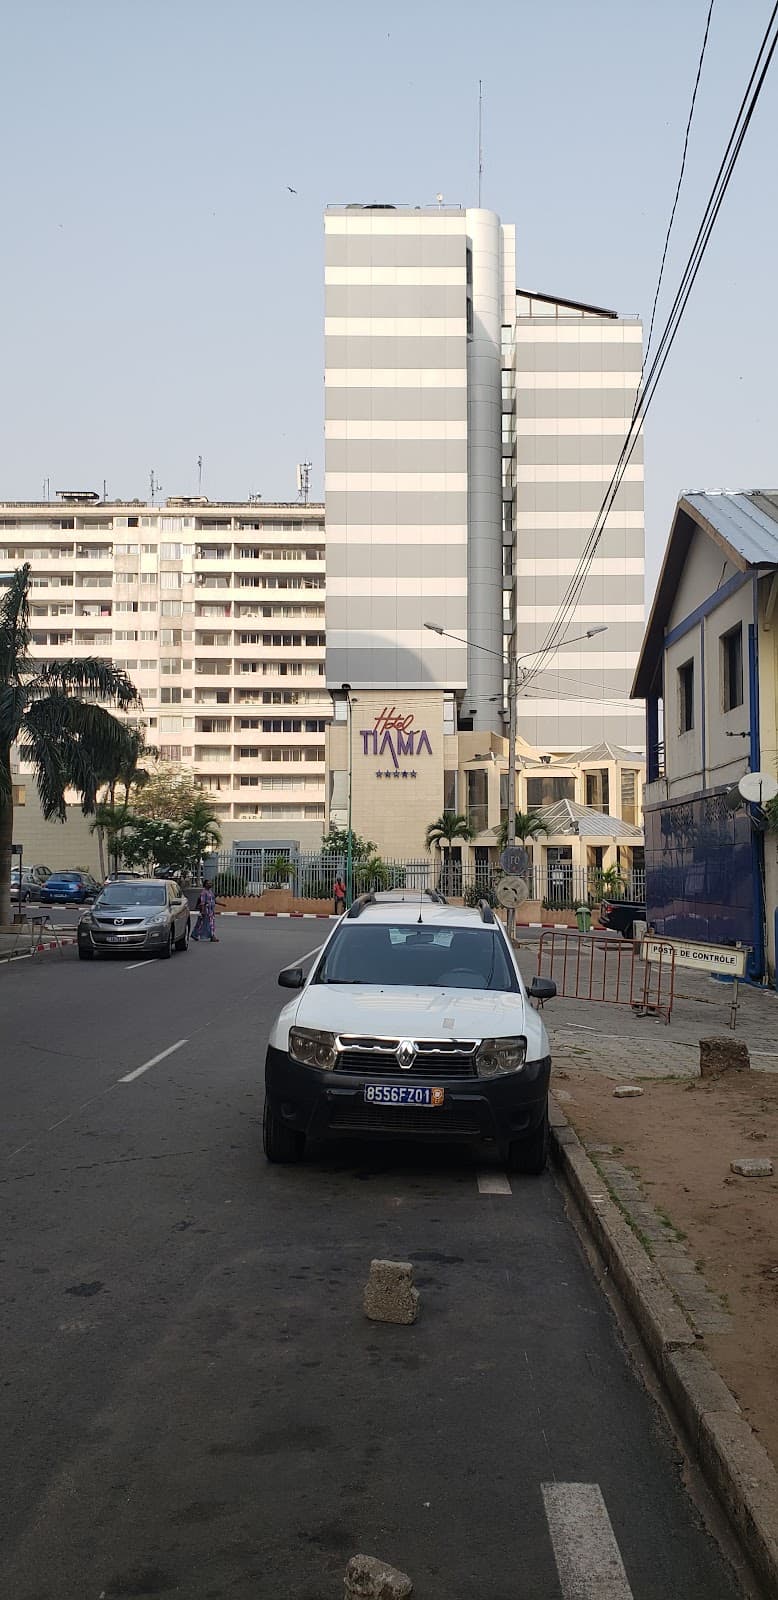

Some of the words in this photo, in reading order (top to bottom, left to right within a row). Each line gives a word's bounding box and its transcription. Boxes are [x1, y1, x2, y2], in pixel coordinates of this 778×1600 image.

[374, 707, 420, 735] Hotel
[360, 730, 432, 768] TIAMA
[680, 949, 690, 957] DE
[692, 952, 735, 964] CONTRÔLE
[367, 1086, 430, 1103] 8556FZ01
